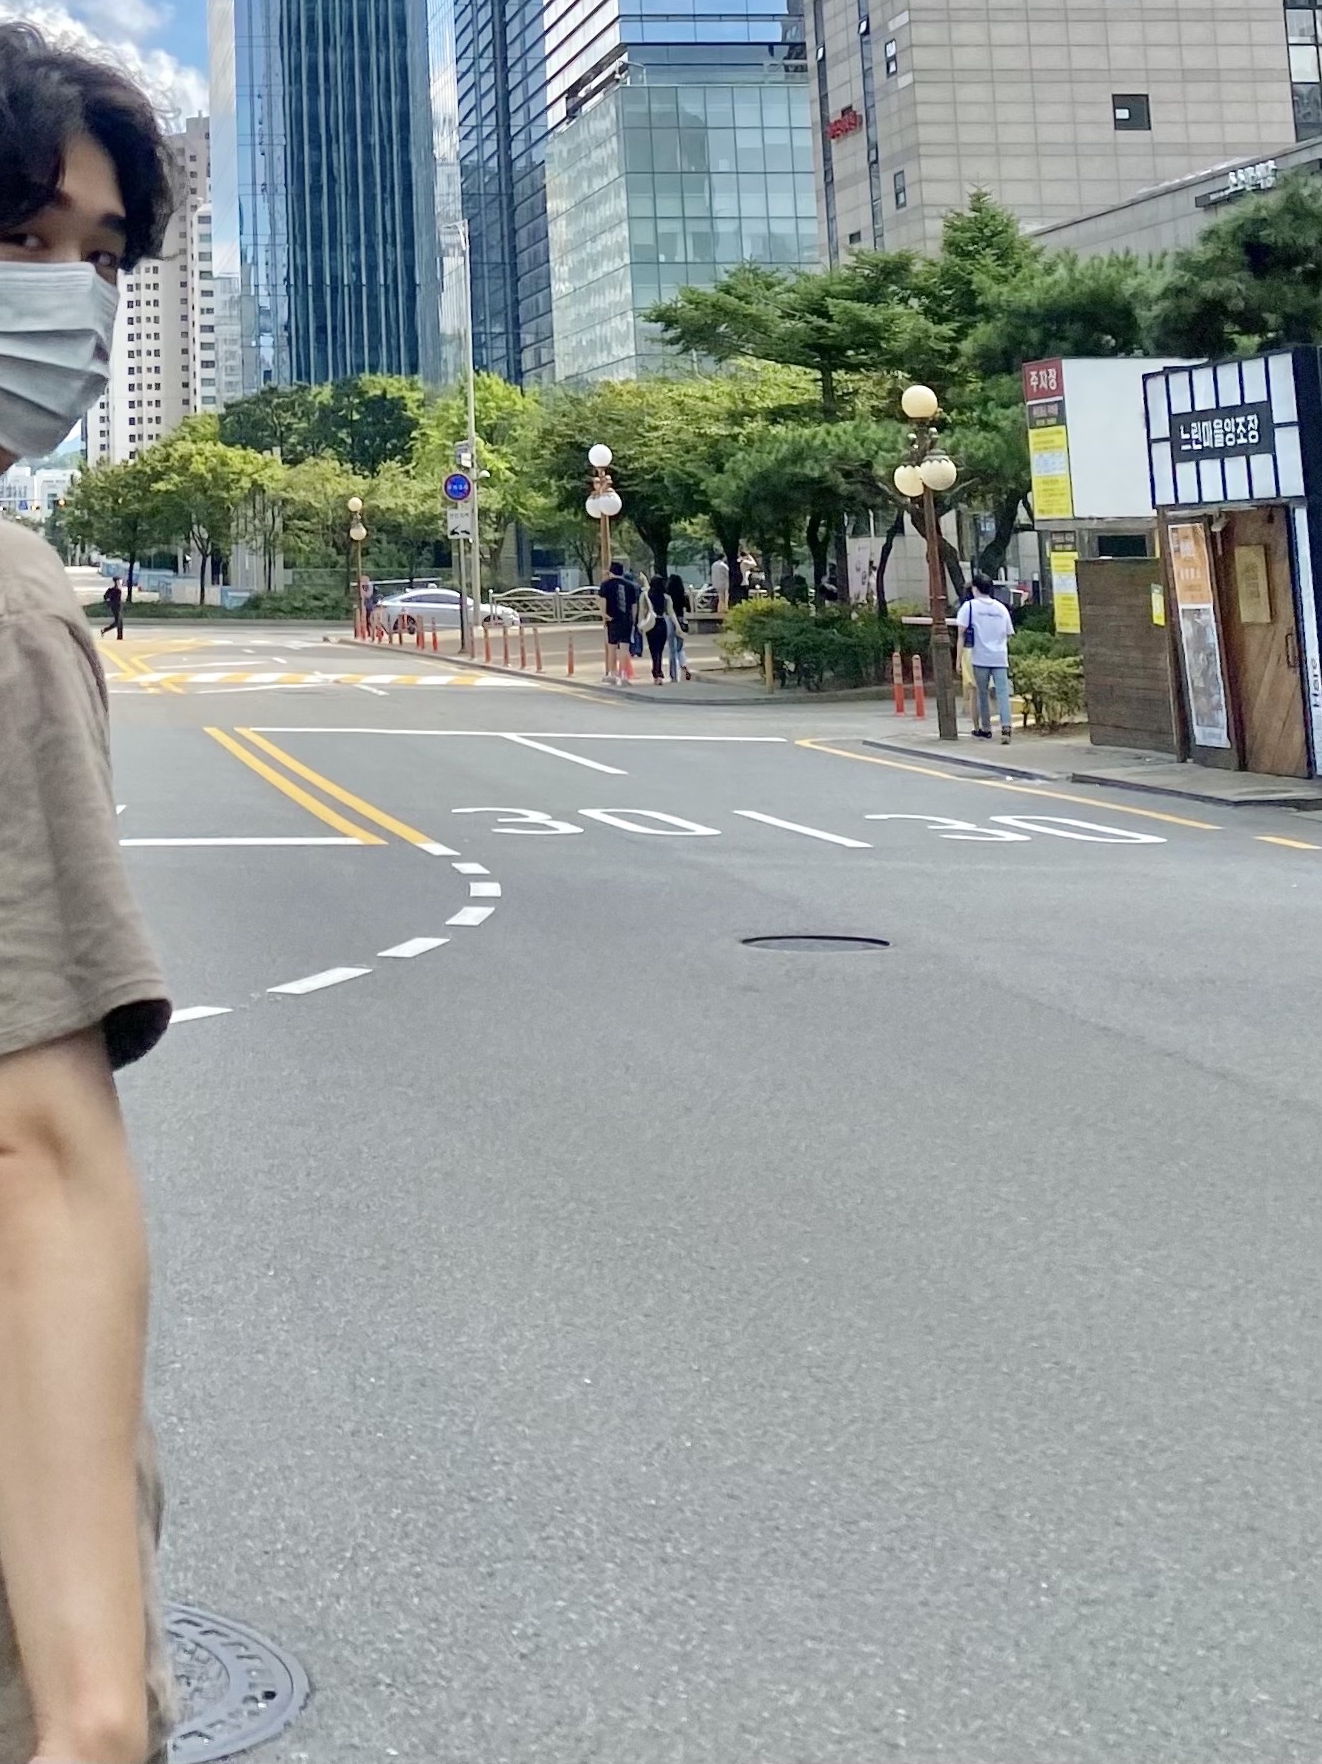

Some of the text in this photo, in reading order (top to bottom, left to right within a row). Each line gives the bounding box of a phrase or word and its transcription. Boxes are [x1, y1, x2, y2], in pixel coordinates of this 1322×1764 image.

[1029, 368, 1057, 393] 주차장
[1180, 414, 1259, 450] 느린마을양조장
[451, 807, 722, 836] 30
[864, 814, 1168, 843] 30
